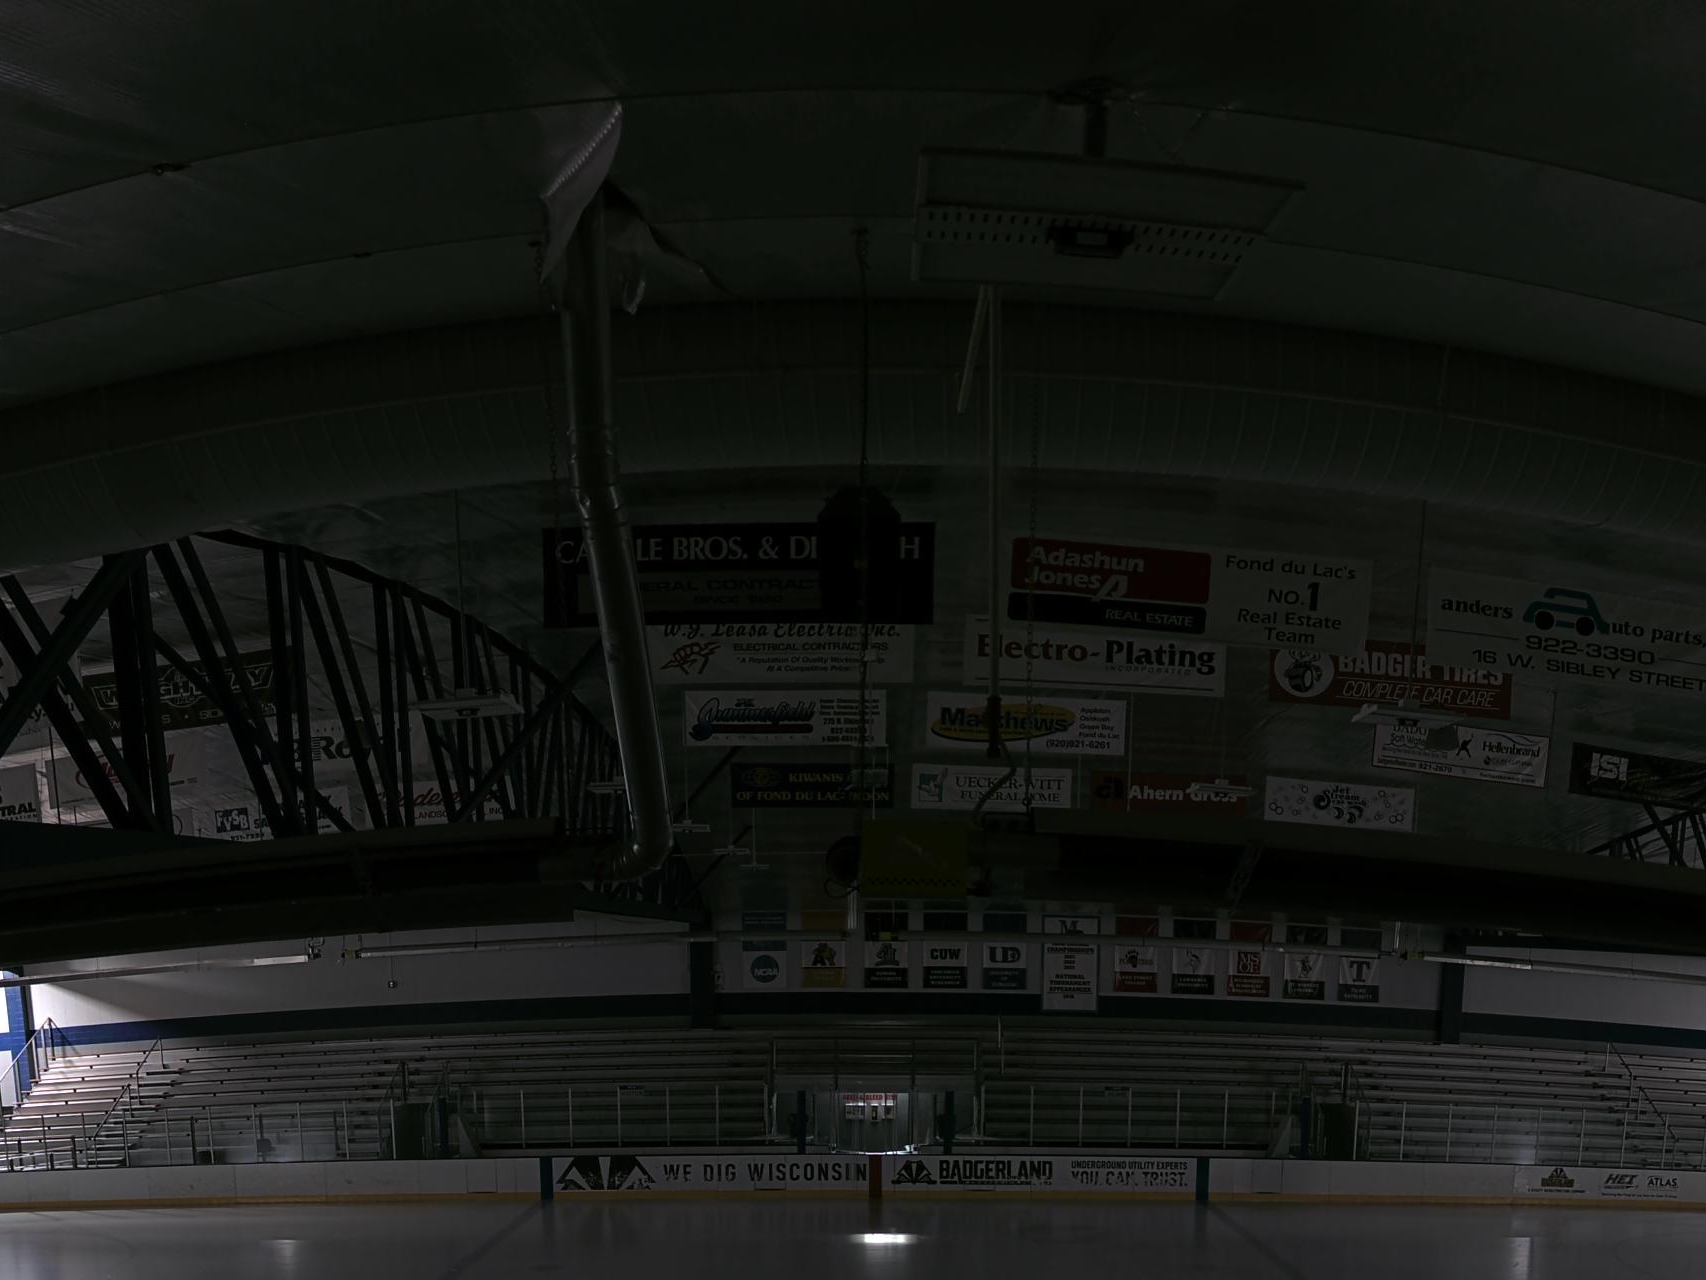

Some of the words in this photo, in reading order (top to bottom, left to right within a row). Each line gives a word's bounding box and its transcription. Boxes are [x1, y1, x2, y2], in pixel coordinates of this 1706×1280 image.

[673, 536, 749, 561] BROS.
[758, 537, 779, 560] &
[1027, 546, 1145, 573] Adashun
[1225, 555, 1274, 572] Fond
[1281, 558, 1305, 575] du
[1313, 563, 1356, 580] Lac's
[1024, 566, 1102, 589] Jones
[1105, 608, 1141, 622] REAL
[1145, 612, 1193, 627] ESTATE
[1238, 608, 1277, 625] Real
[1285, 611, 1341, 630] Estate
[1441, 598, 1514, 620] anders
[1651, 627, 1706, 648] parts,
[1265, 627, 1315, 645] Team
[733, 643, 800, 651] ELECTRICAL
[1525, 635, 1656, 665] 922-3390
[1472, 650, 1497, 664] 16
[1507, 653, 1535, 670] W.
[1546, 659, 1621, 680] SIBLEY
[1423, 687, 1453, 703] CAR
[1457, 689, 1495, 708] CARE
[1482, 741, 1541, 758] Hellenbrand
[789, 772, 843, 782] KIWANIS
[736, 791, 755, 801] OF
[757, 791, 791, 801] FOND
[795, 791, 814, 801] DU
[1129, 785, 1183, 801] Ahern
[930, 948, 961, 960] CUW
[1349, 960, 1371, 983] T
[663, 1163, 692, 1183] WE
[704, 1163, 737, 1183] DIG
[747, 1162, 867, 1183] WISCONSIN
[939, 1160, 1053, 1184] BADGERLAND
[1071, 1161, 1126, 1170] UNDERGROUND
[1128, 1161, 1155, 1170] UTILITY
[1156, 1161, 1188, 1171] EXPERTS
[1647, 1177, 1678, 1187] ATLAS
